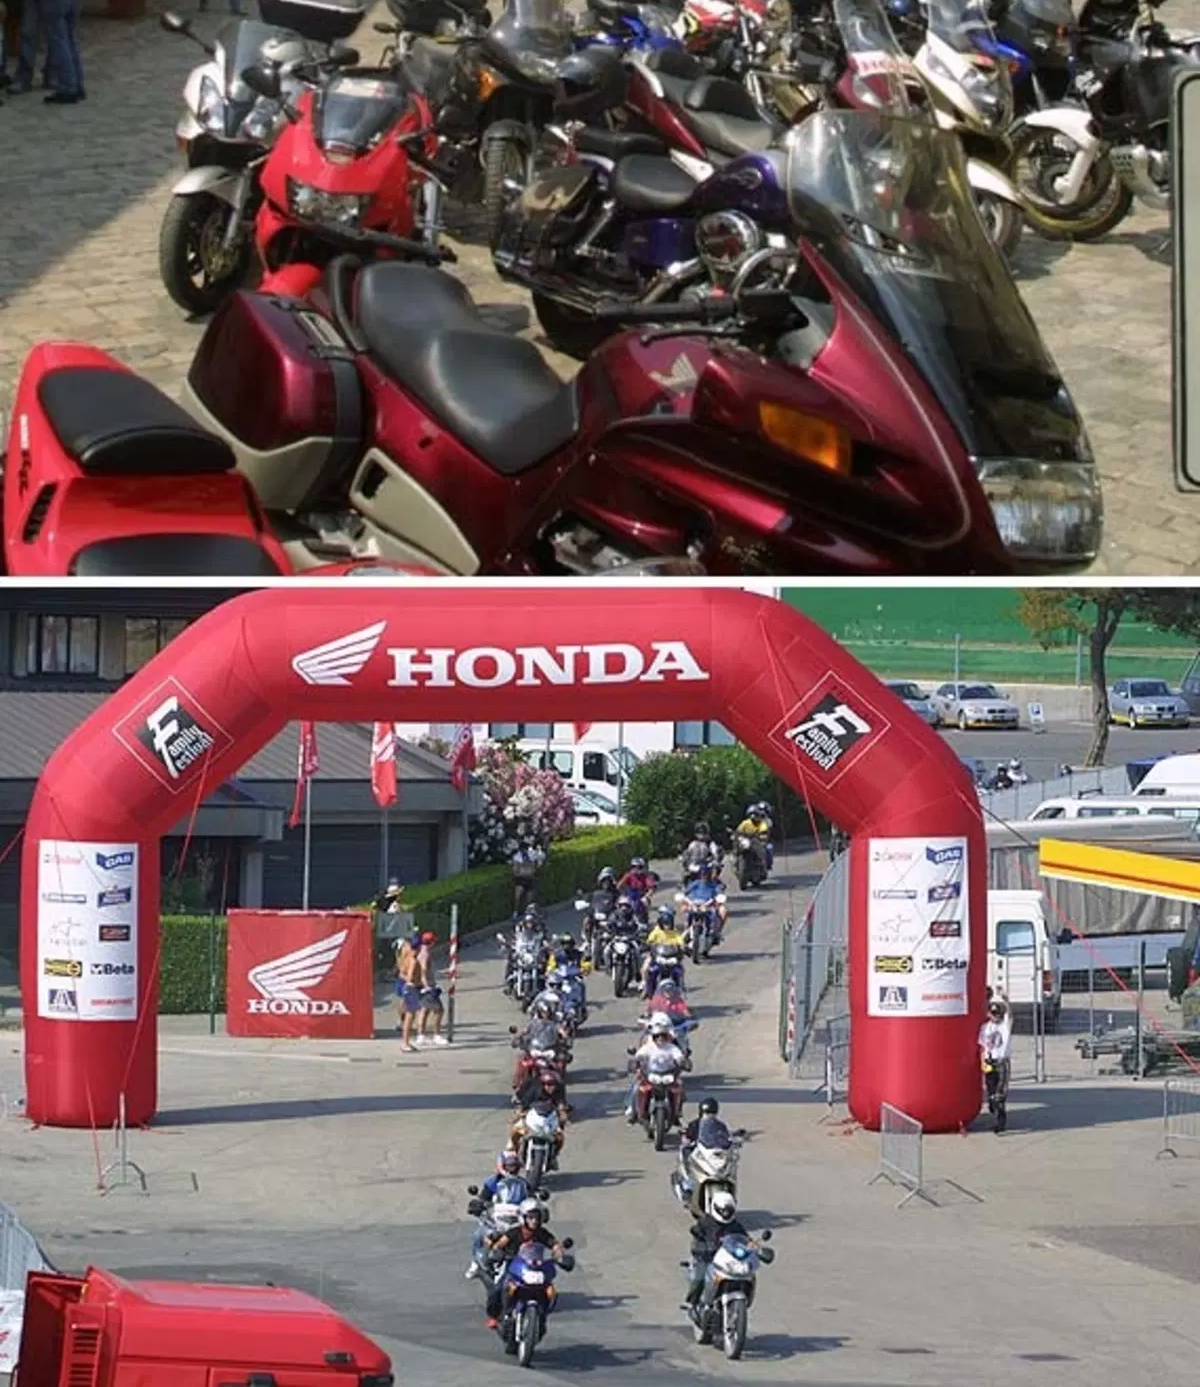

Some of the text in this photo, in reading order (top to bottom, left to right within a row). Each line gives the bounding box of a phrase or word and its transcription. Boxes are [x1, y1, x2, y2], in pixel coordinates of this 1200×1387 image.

[386, 640, 710, 689] HONDA
[103, 962, 136, 976] Beta
[935, 958, 968, 970] Beta
[246, 998, 351, 1016] HONDA
